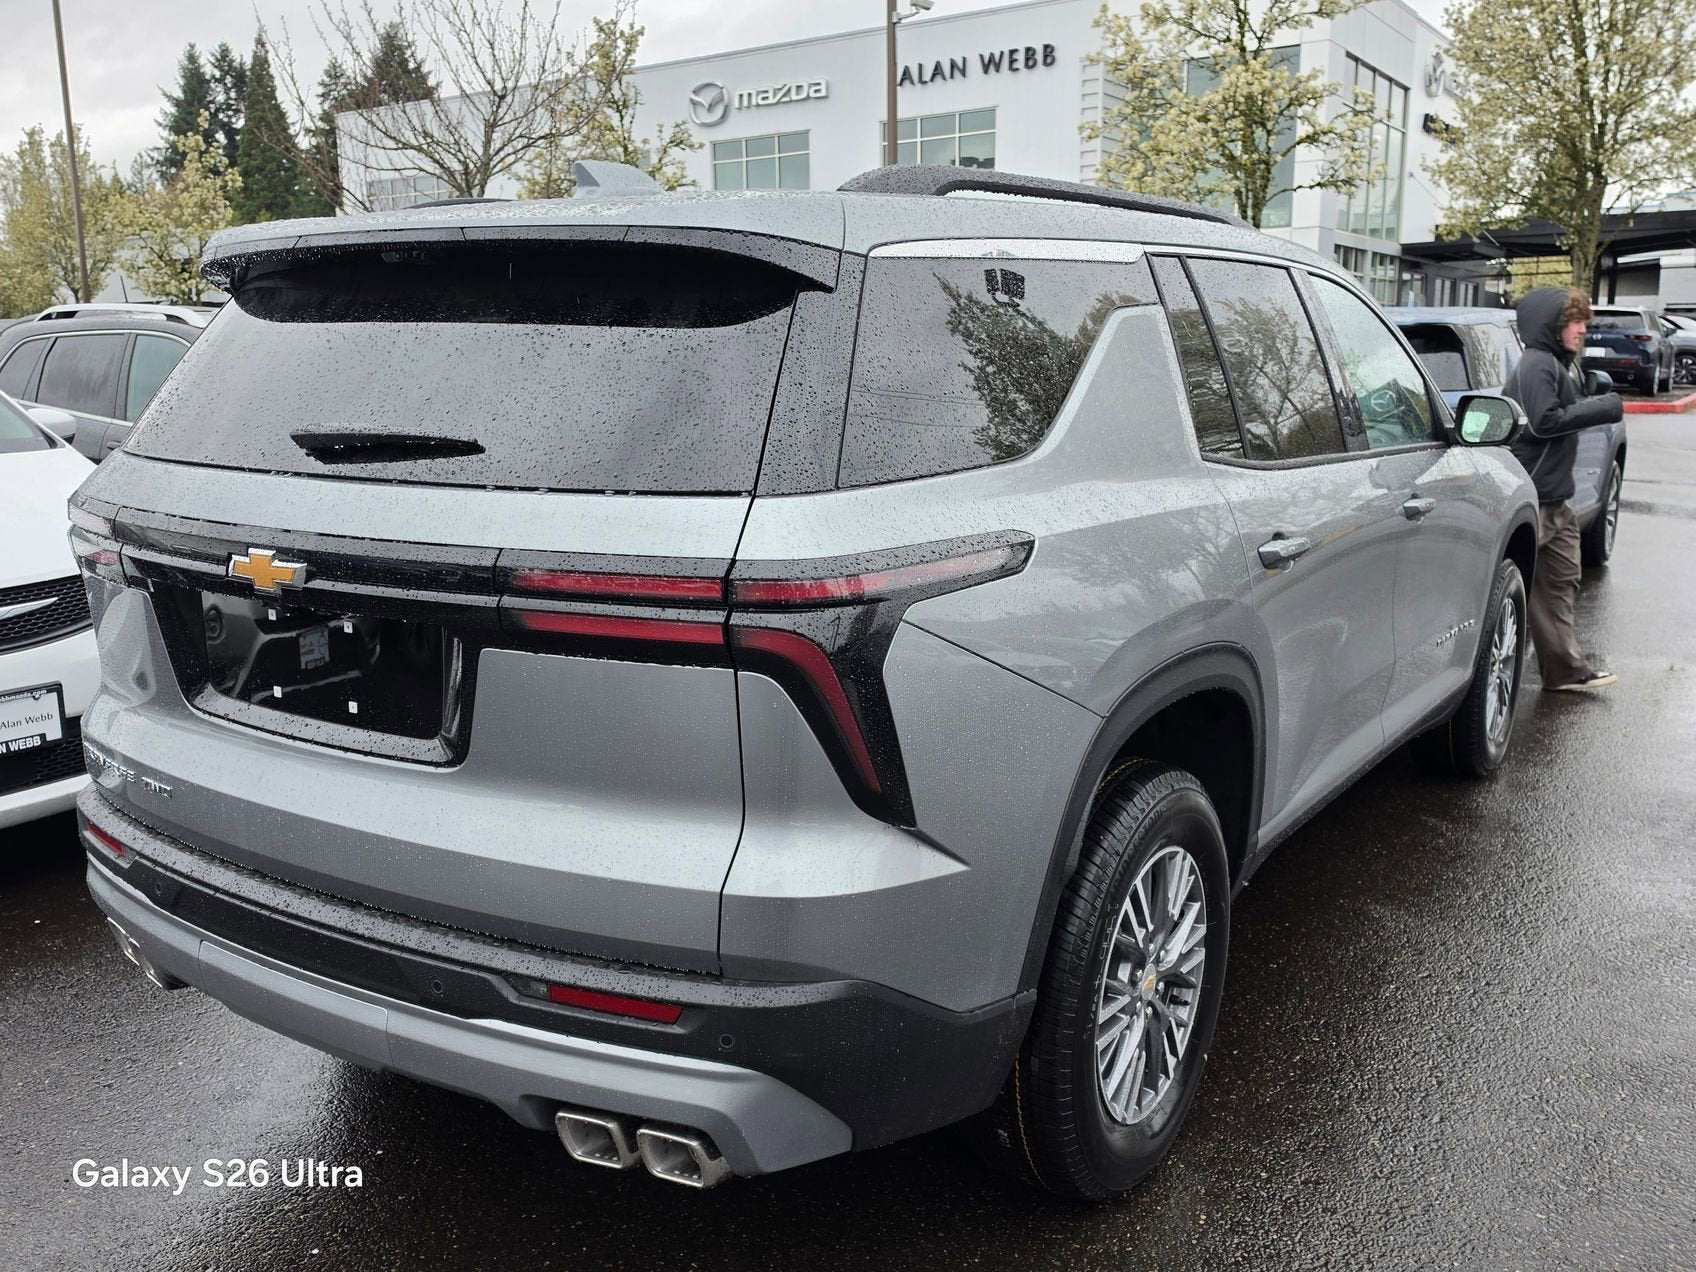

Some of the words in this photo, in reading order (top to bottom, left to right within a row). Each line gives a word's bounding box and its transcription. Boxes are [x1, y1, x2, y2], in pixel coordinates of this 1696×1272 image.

[896, 56, 967, 87] ALAN
[979, 43, 1057, 75] WEBB
[733, 77, 829, 110] mazda
[0, 720, 22, 729] Alan
[24, 712, 53, 725] Webb
[8, 735, 41, 752] WEBB
